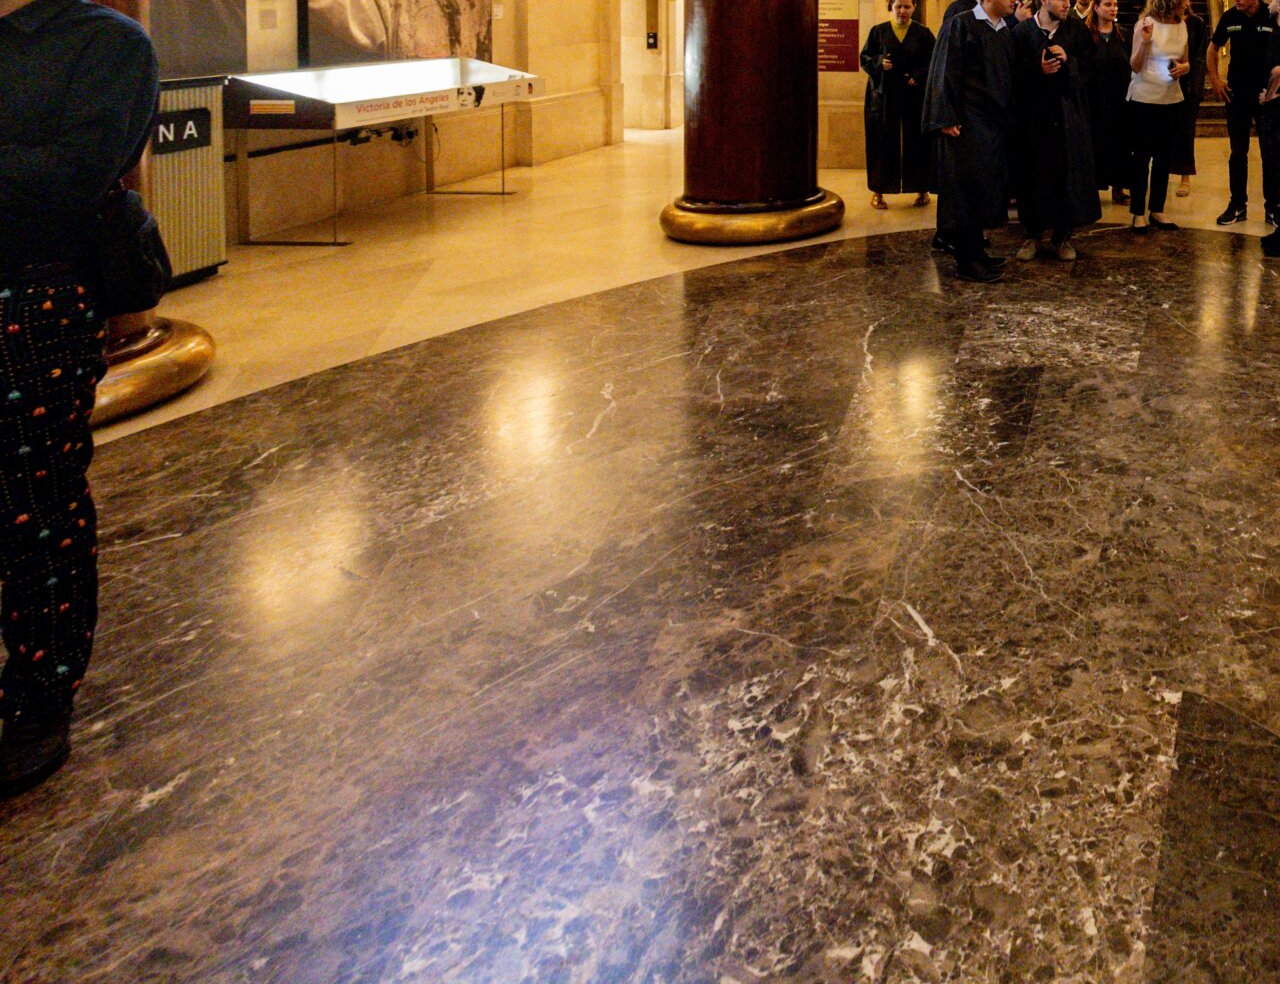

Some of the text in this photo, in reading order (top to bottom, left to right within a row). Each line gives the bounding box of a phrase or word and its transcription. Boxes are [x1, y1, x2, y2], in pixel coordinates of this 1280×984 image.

[356, 102, 390, 113] Victoria
[392, 99, 403, 109] de
[405, 97, 416, 107] los
